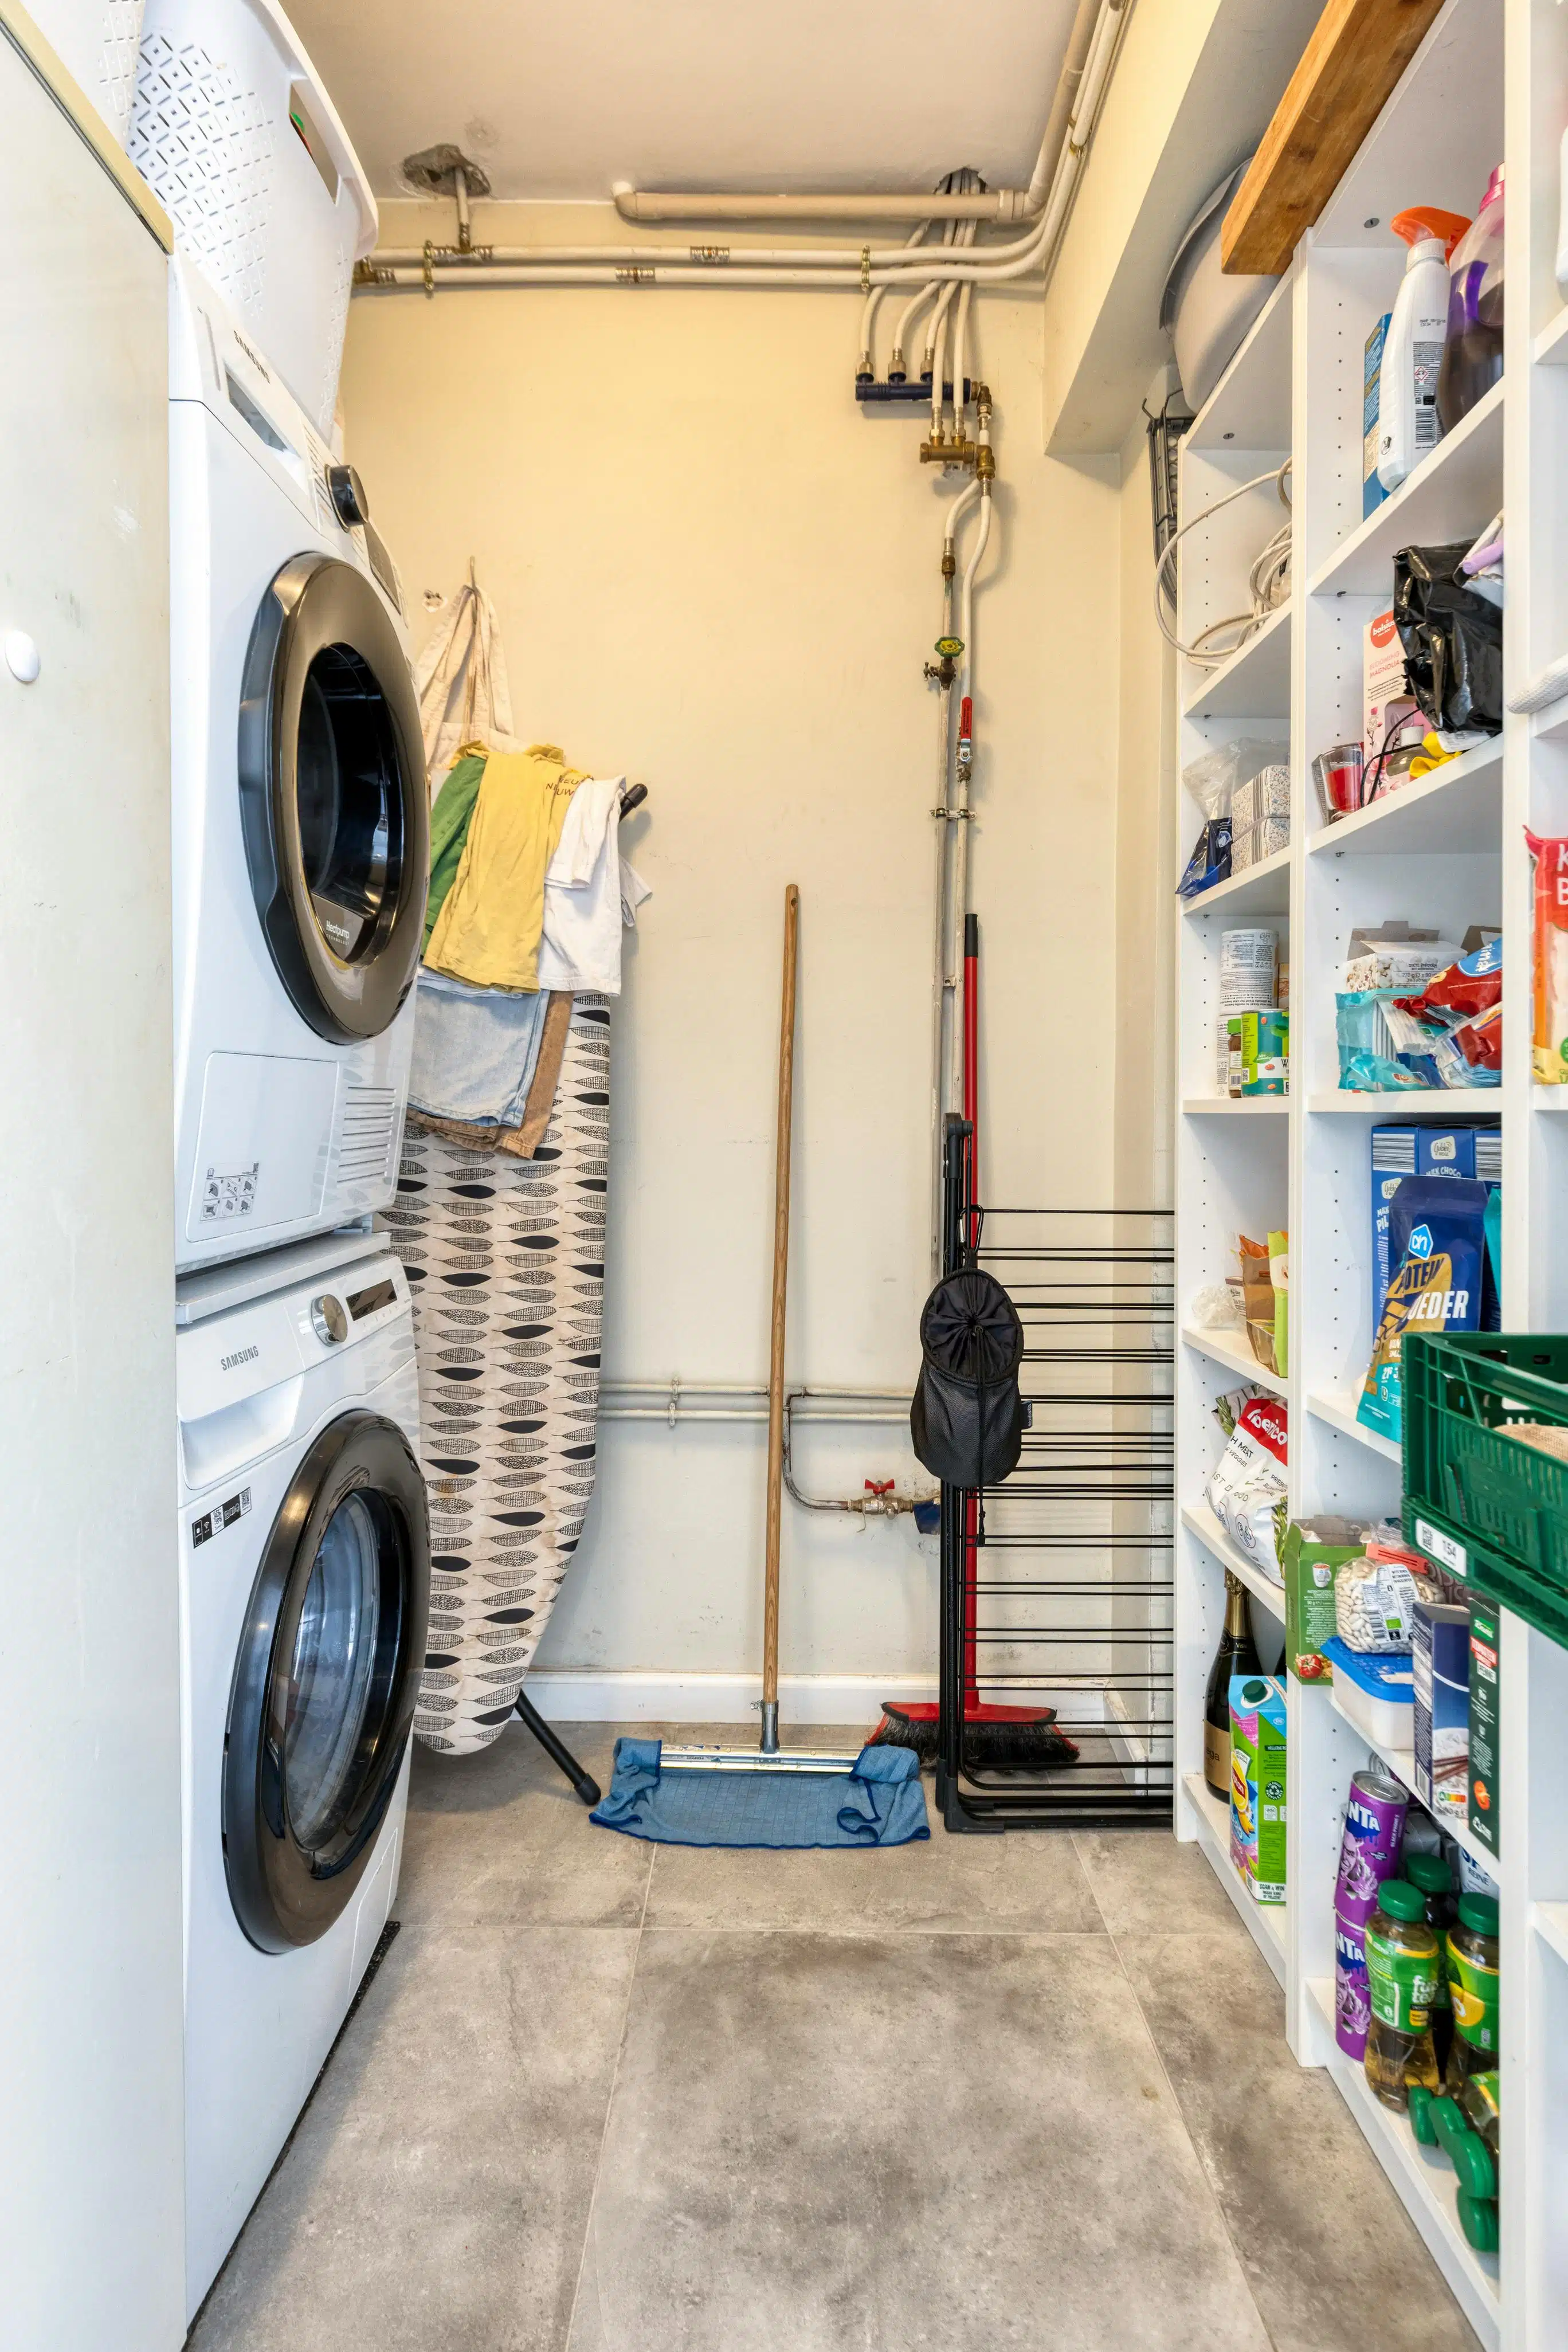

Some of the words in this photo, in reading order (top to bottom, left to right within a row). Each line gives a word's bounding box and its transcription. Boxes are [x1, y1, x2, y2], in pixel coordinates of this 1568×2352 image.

[1369, 650, 1400, 671] BLOOMING
[1369, 660, 1401, 679] MAGNOLIA
[326, 920, 350, 940] Heatpump
[220, 1345, 259, 1371] SAMSUNG
[1229, 1449, 1248, 1468] VEGGIES
[1238, 1441, 1254, 1459] MEAT
